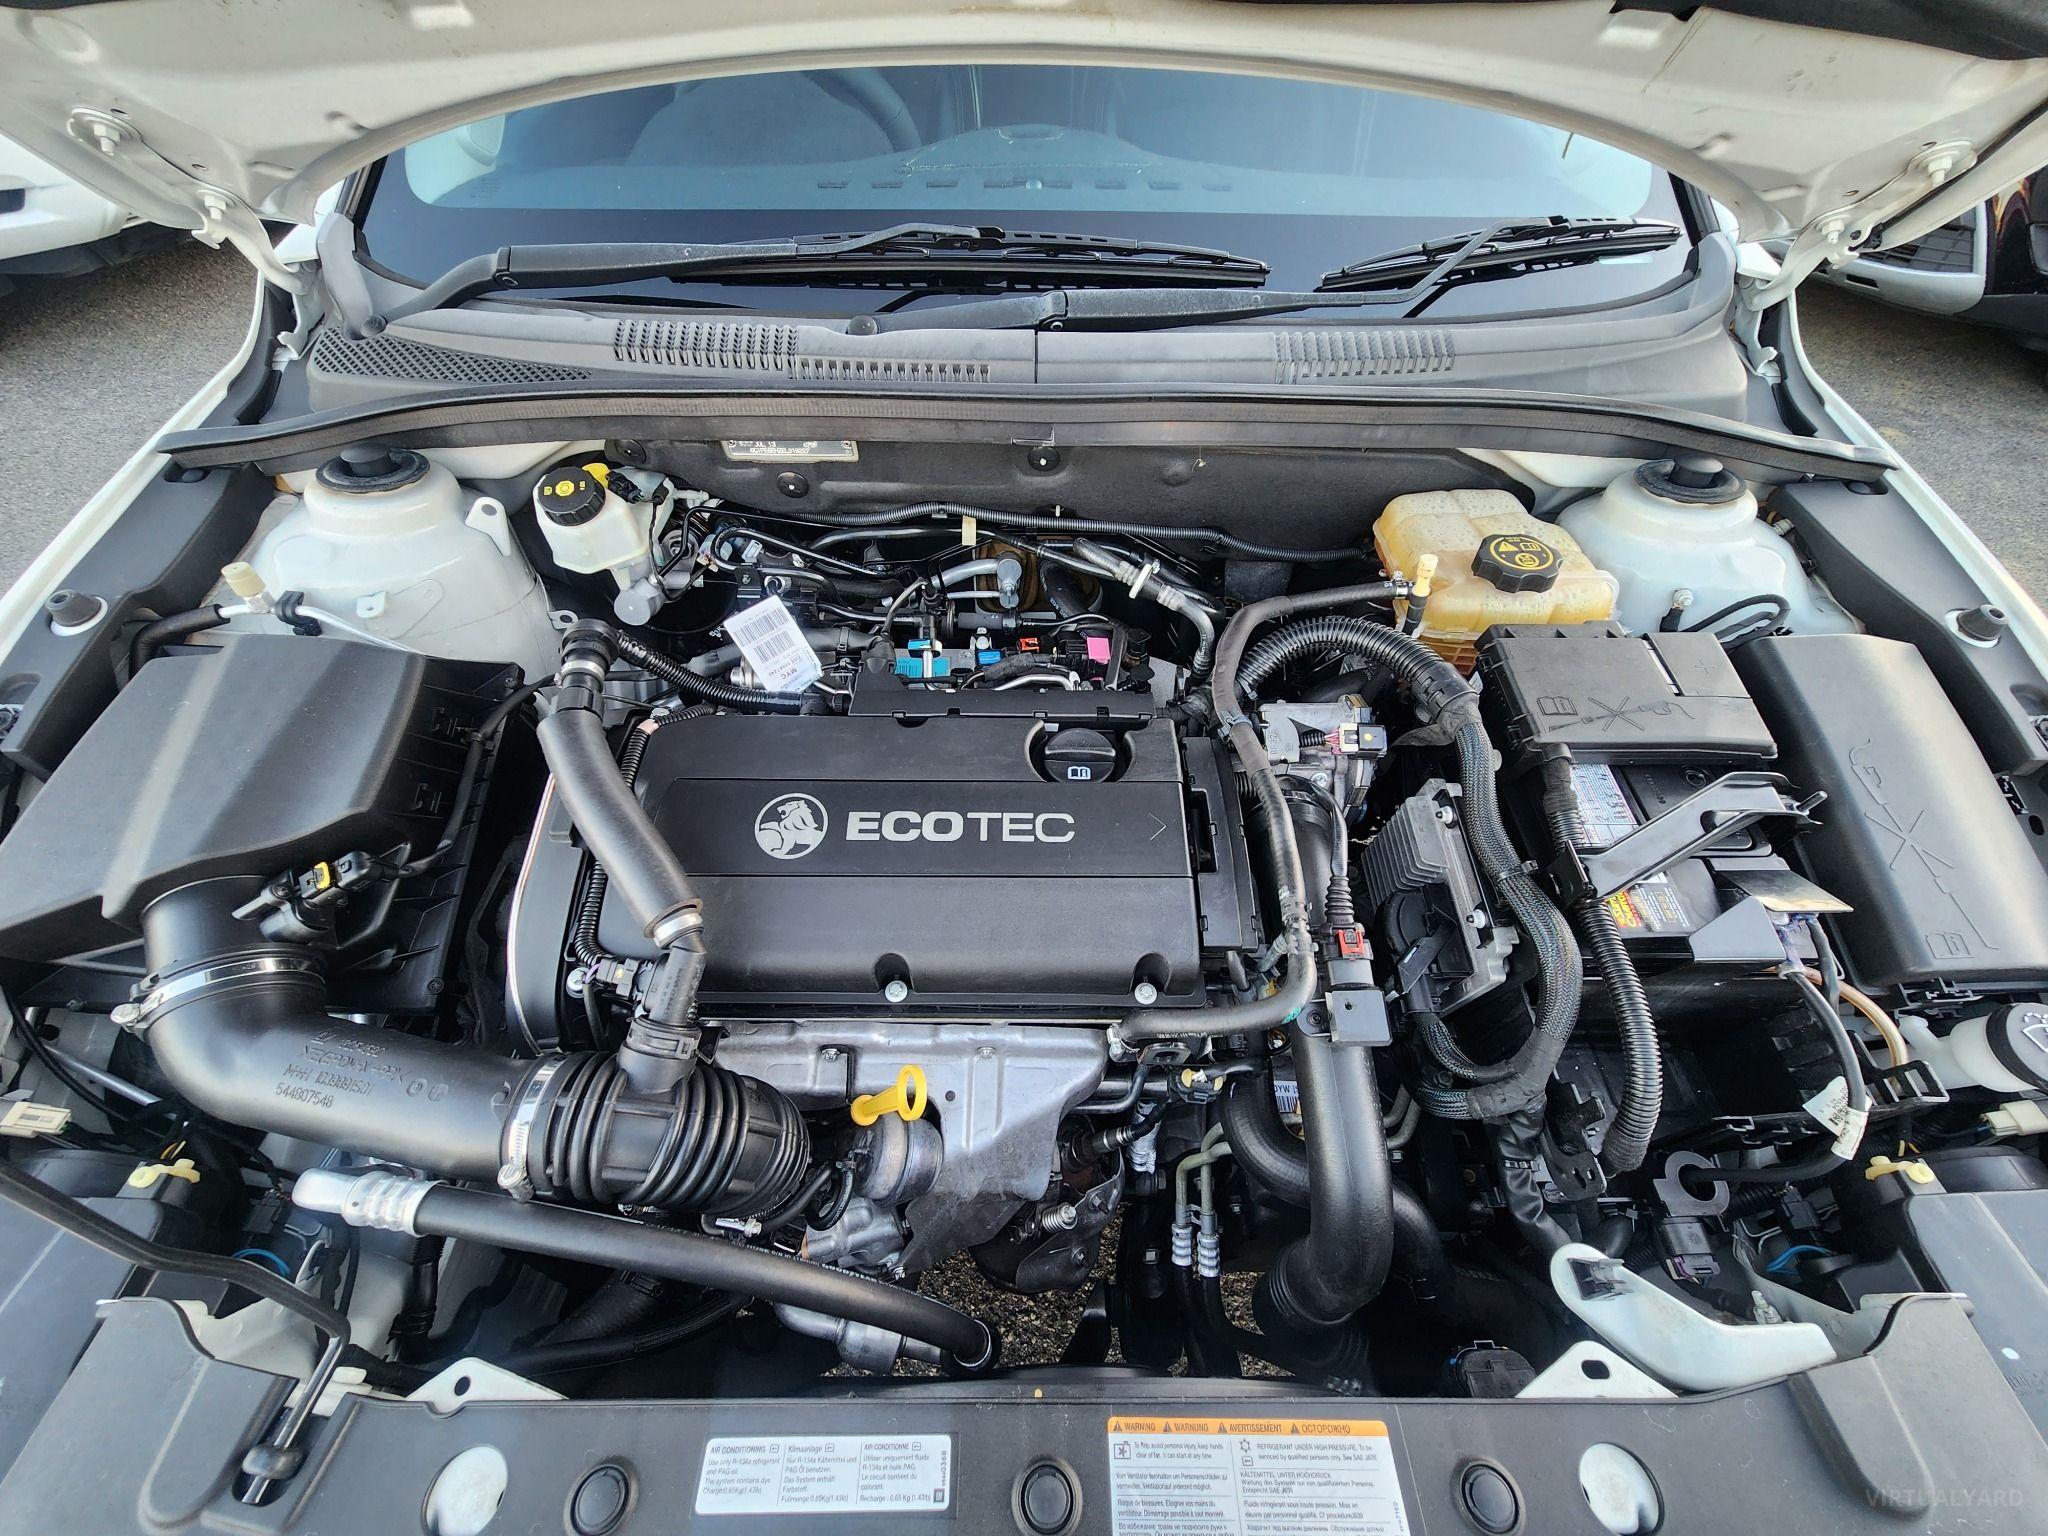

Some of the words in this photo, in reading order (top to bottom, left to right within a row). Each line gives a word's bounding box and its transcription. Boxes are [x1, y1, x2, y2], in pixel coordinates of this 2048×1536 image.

[846, 811, 1075, 842] ECOTEC
[1124, 1422, 1156, 1432] WARNING
[1174, 1422, 1208, 1432] WARNUNG
[1229, 1423, 1282, 1433] AVERTISSEMENT
[1302, 1424, 1350, 1434] ОСТОРОЖНО
